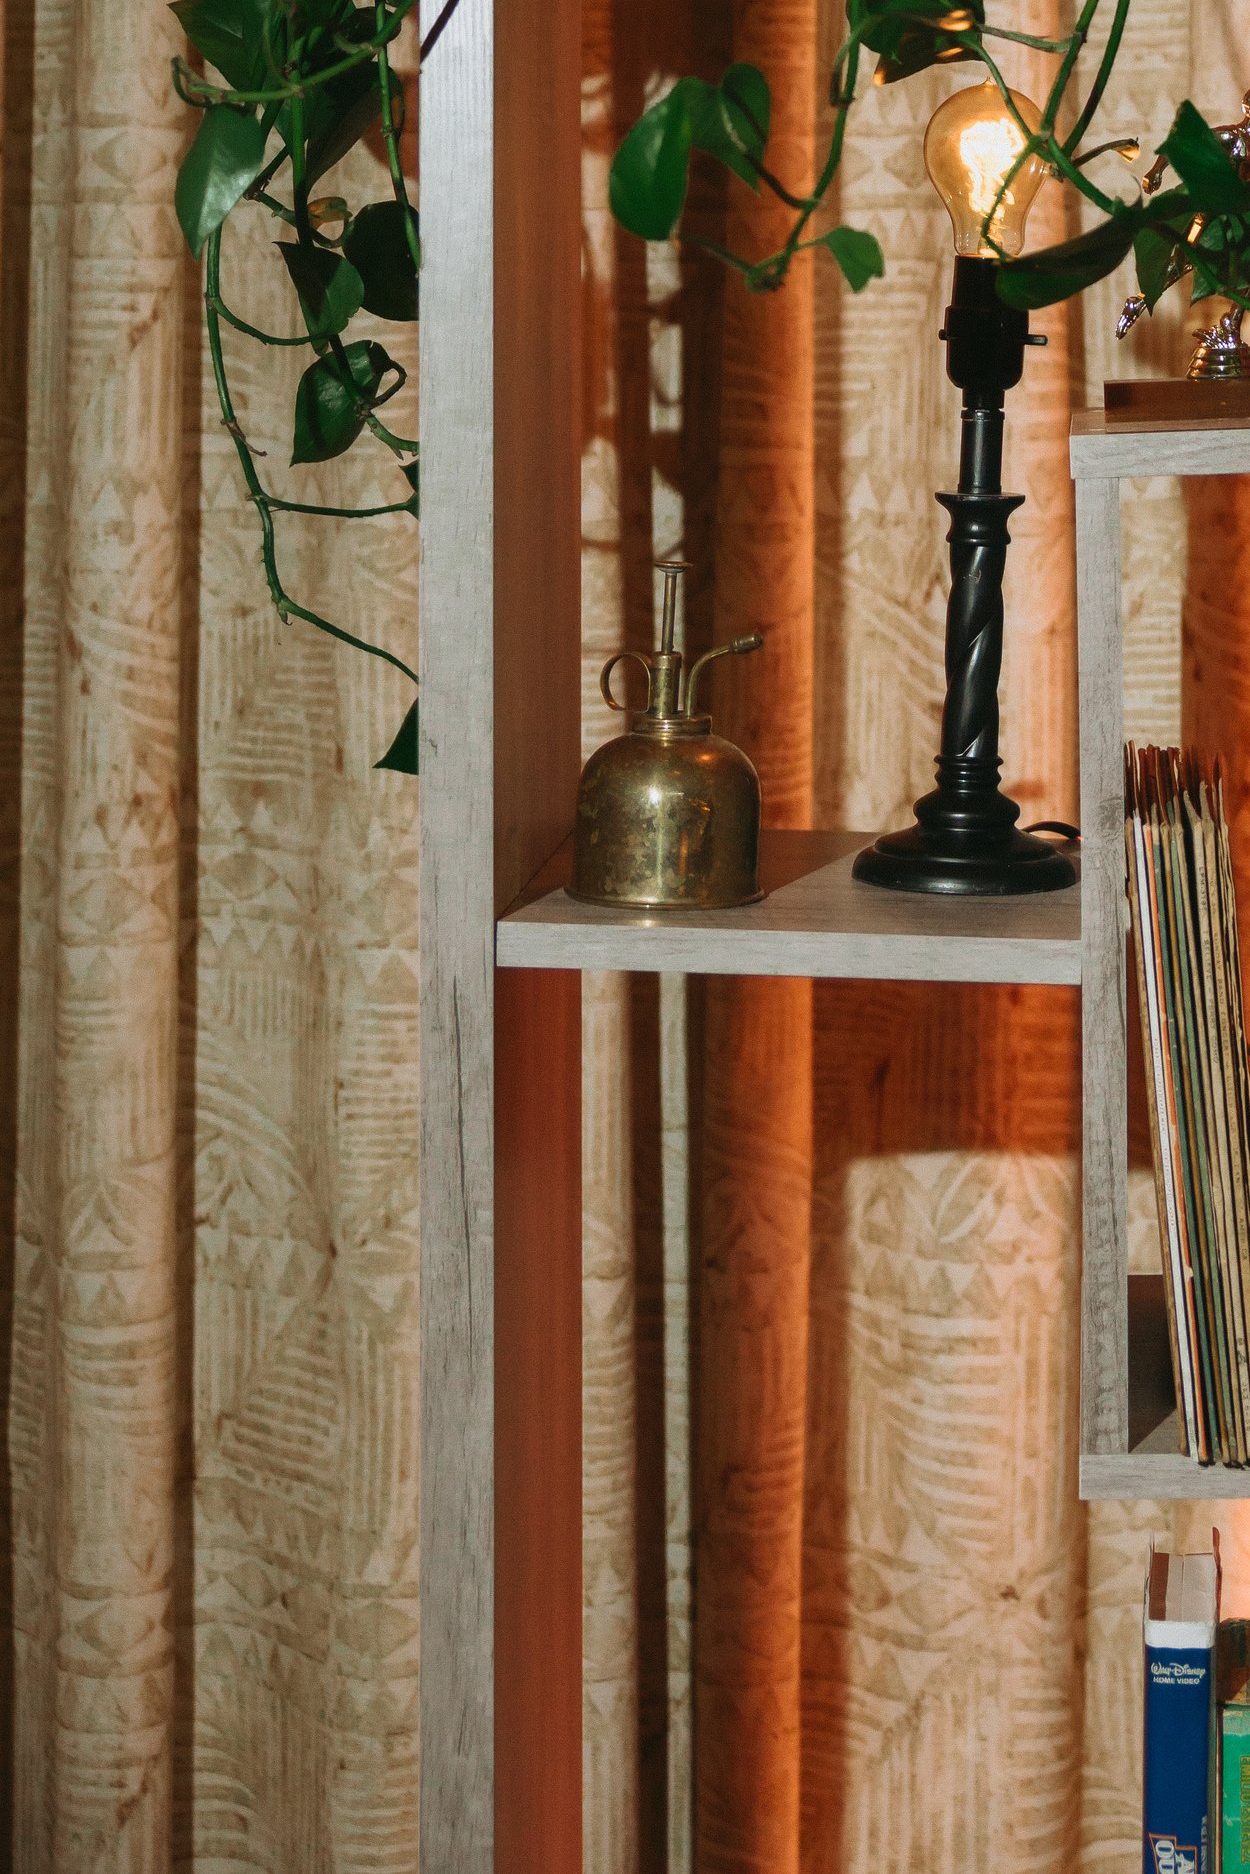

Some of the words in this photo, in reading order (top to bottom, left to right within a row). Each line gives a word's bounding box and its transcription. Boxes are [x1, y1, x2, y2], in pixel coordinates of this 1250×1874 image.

[1211, 1035, 1219, 1064] COMO
[1151, 1662, 1171, 1677] Walt
[1170, 1662, 1206, 1679] Disney
[1153, 1676, 1176, 1684] HOME
[1176, 1677, 1200, 1685] VIDEO
